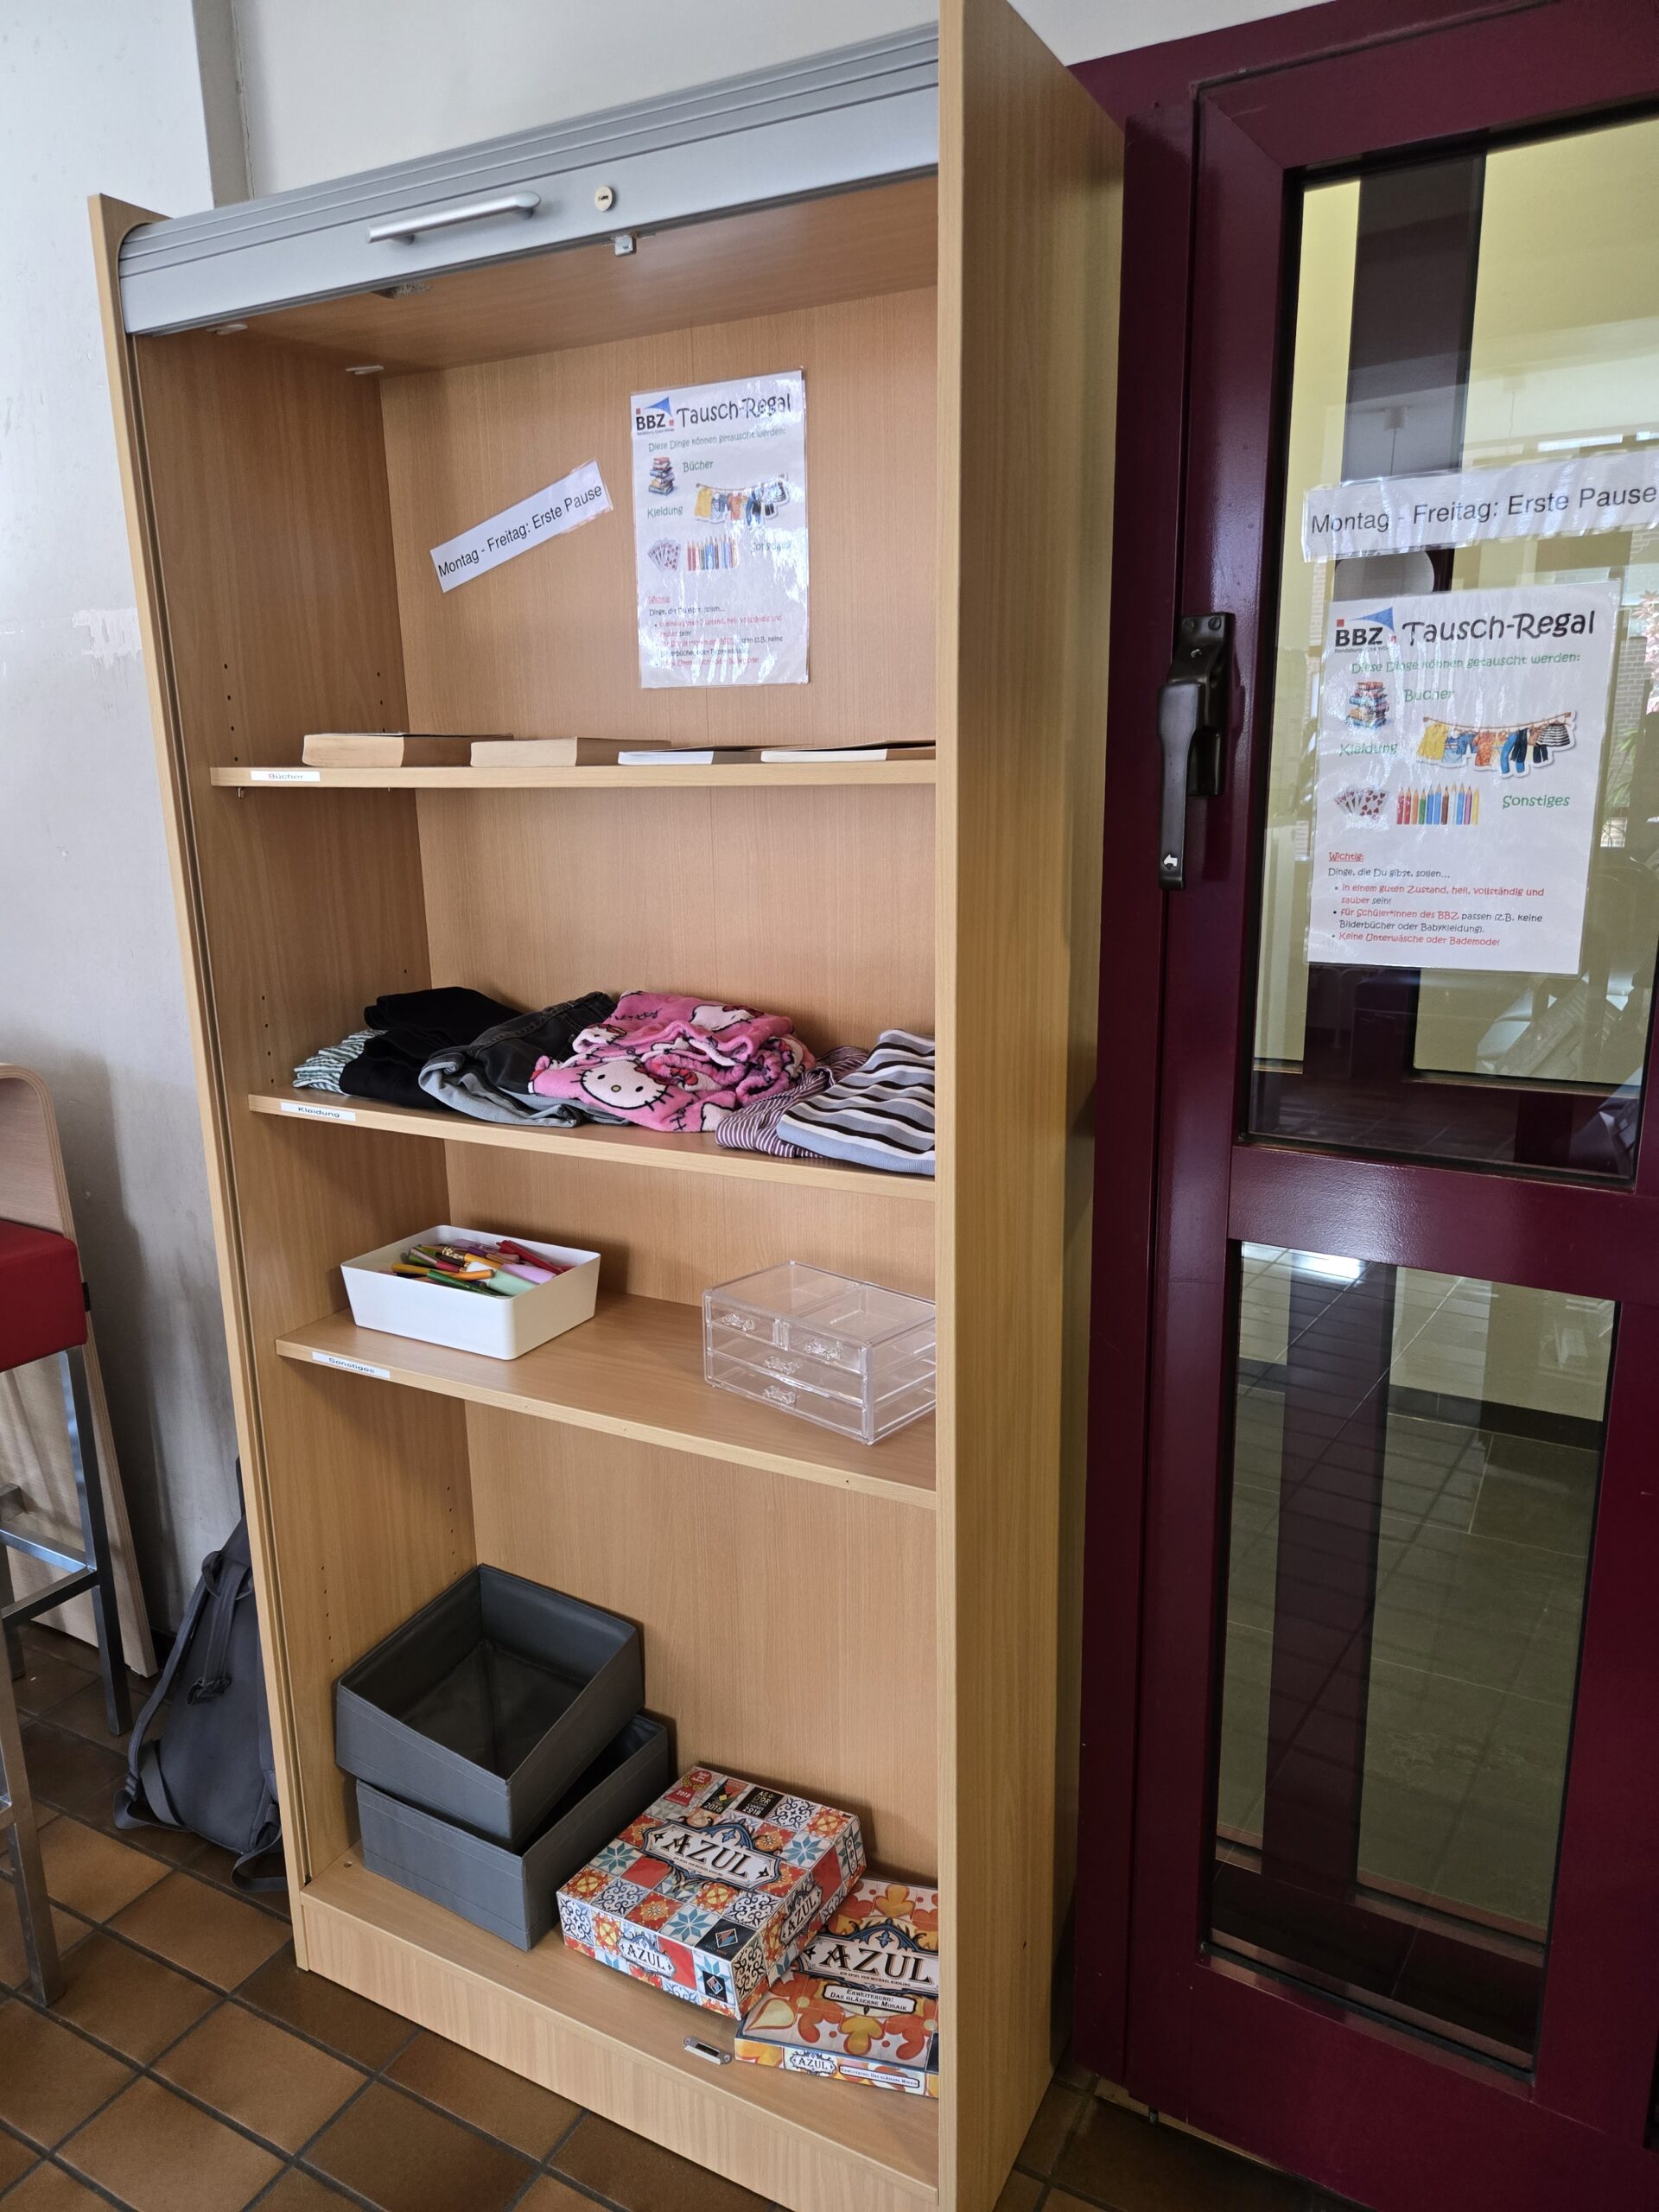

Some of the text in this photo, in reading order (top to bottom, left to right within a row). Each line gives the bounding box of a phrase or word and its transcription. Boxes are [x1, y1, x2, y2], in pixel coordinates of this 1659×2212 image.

[636, 393, 791, 430] BBZ Tausch-Regal
[649, 442, 668, 452] Diese
[670, 439, 690, 449] Dinge
[691, 436, 717, 446] können
[683, 461, 714, 473] Bücher
[647, 505, 683, 518] Kleidung
[1311, 512, 1389, 535] Montag
[1413, 502, 1499, 524] Freitag:
[1507, 493, 1569, 516] Erste
[1579, 486, 1657, 509] Pause
[438, 550, 480, 577] Montag
[486, 523, 531, 552] Freitag:
[532, 506, 563, 529] Erste
[564, 486, 602, 512] Pause
[1335, 610, 1595, 647] BBZ Tausch-Regal
[1466, 654, 1527, 669] getauscht
[1530, 652, 1580, 664] werden:
[1503, 794, 1570, 809] Sonstiges
[1328, 852, 1364, 862] Wichtig:
[1328, 868, 1355, 877] Dinge,
[1357, 868, 1371, 876] die
[1373, 868, 1387, 877] Du
[1389, 868, 1413, 878] gibst,
[1352, 884, 1377, 893] einem
[1378, 885, 1405, 893] guten
[1407, 885, 1449, 894] Zustand,
[1473, 887, 1523, 897] vollständig
[1526, 888, 1544, 897] und
[1341, 896, 1370, 905] sauber
[1438, 911, 1459, 920] BBZ
[1462, 912, 1492, 921] passen
[1517, 913, 1543, 922] keine
[1339, 919, 1395, 930] Bilderbücher
[1397, 922, 1418, 931] oder
[1338, 932, 1363, 941] Keine
[1365, 933, 1423, 944] Unterwäsche
[1449, 936, 1500, 947] Bademode!
[298, 1107, 340, 1118] Kleidung
[328, 1357, 375, 1374] Sonstiges
[704, 1802, 723, 1813] 2018
[661, 1834, 750, 1878] AZUL
[788, 1897, 817, 1934] AZUL
[627, 1944, 664, 1970] AZUL
[820, 1944, 933, 1983] AZUL
[798, 2056, 829, 2070] AZUL
